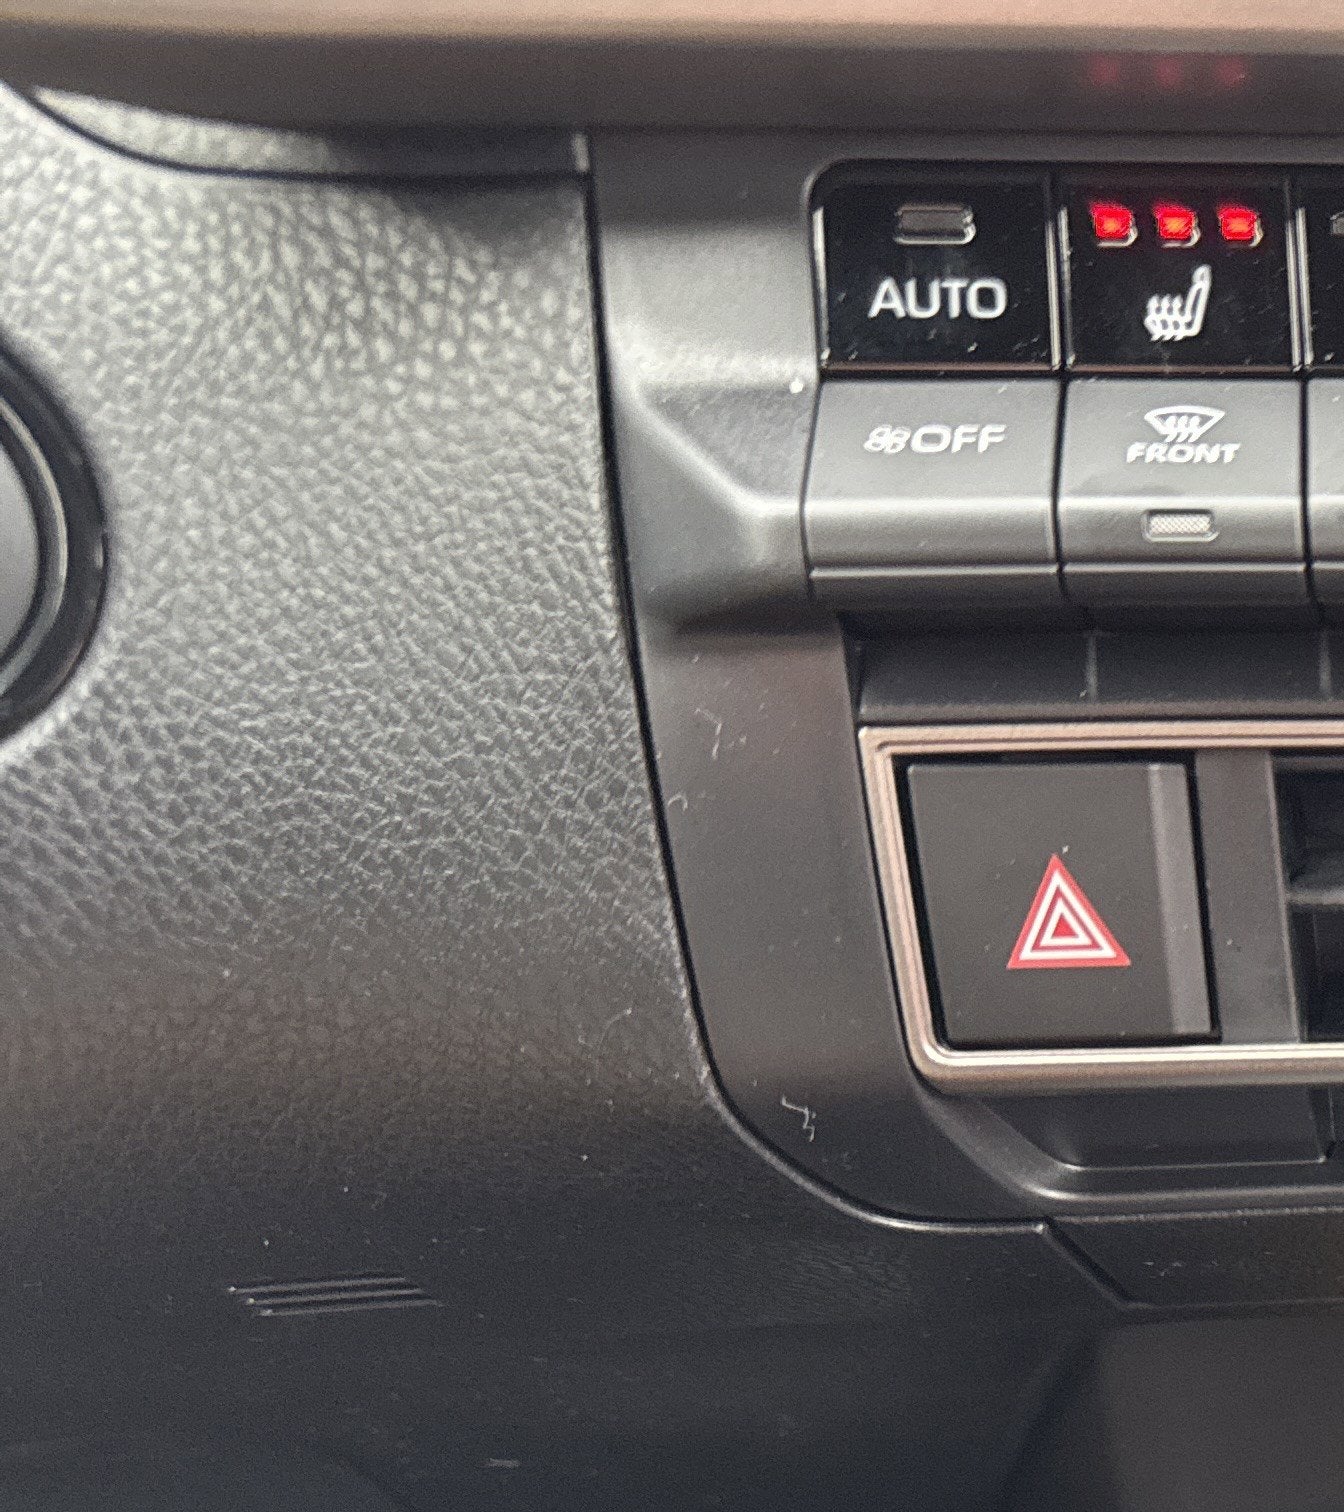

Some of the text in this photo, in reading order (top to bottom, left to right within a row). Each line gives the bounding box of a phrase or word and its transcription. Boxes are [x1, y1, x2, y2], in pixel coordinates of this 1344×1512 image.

[868, 278, 1007, 319] AUTO
[909, 424, 1007, 455] OFF
[1125, 441, 1242, 465] FRONT
